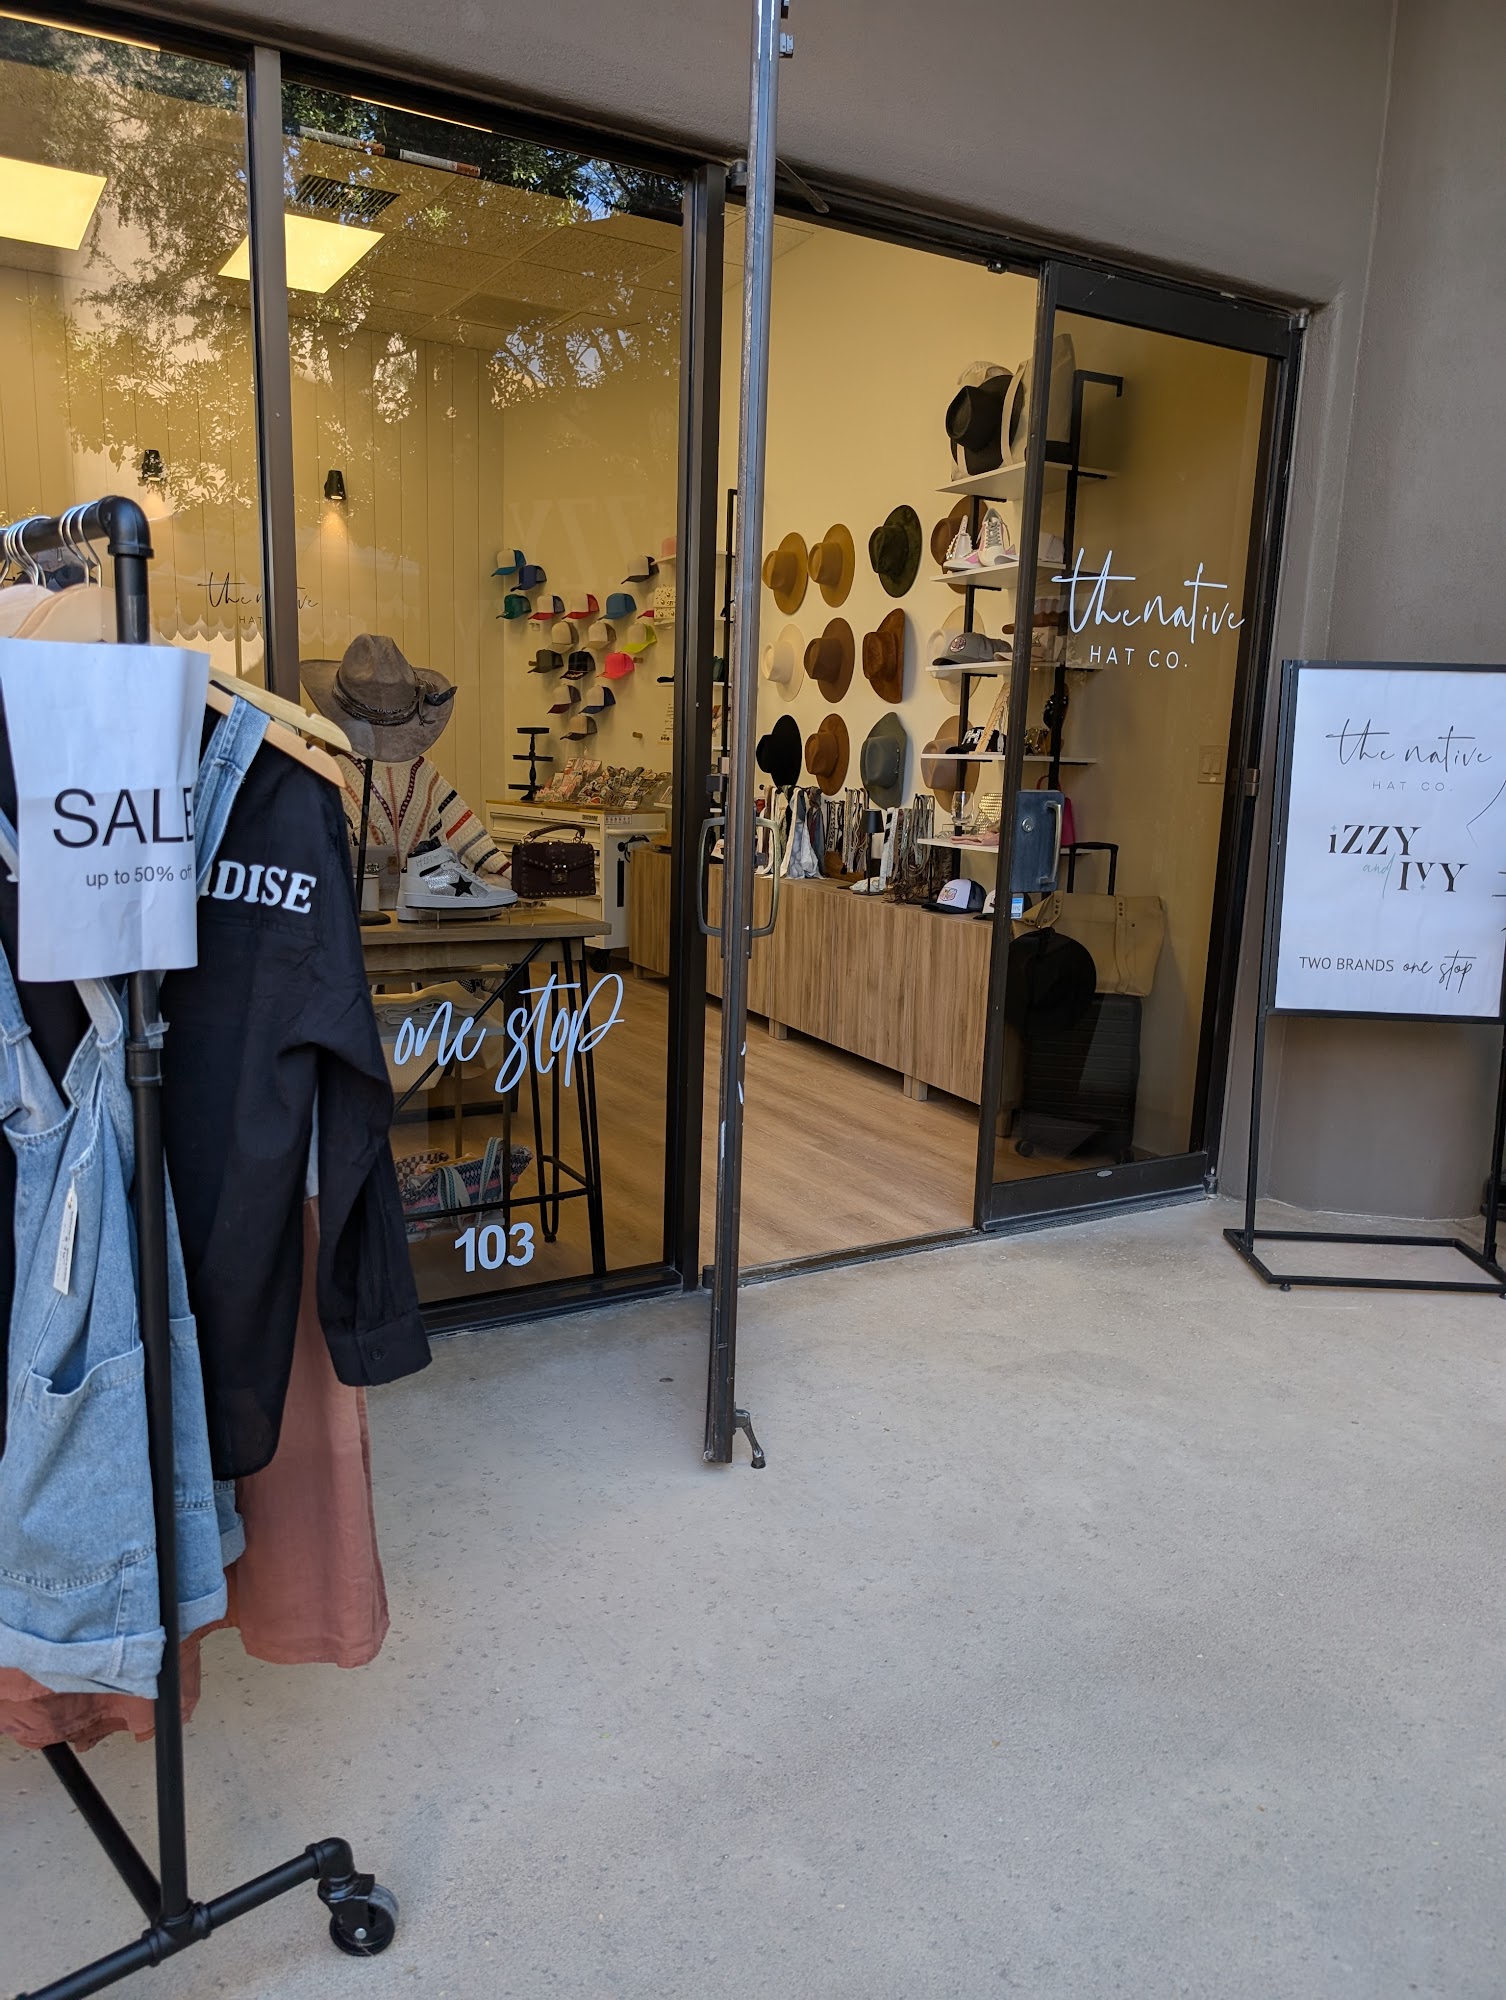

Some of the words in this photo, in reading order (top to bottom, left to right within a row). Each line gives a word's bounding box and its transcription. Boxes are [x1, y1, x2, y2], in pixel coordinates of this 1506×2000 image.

[1090, 645, 1135, 666] HAT
[1149, 649, 1188, 669] CO.
[1326, 718, 1395, 765] the
[1404, 725, 1492, 772] native
[1372, 780, 1407, 791] HAT
[1421, 782, 1453, 792] CO.
[53, 787, 194, 849] SALE
[86, 871, 109, 889] up
[114, 867, 131, 884] to
[134, 866, 174, 883] 50%
[201, 860, 317, 914] DISE
[1362, 853, 1396, 899] and
[1397, 861, 1469, 893] IVY
[1299, 956, 1332, 970] TWO
[1336, 957, 1394, 972] BRANDS
[1403, 959, 1433, 975] one
[1439, 950, 1477, 994] stop
[393, 1001, 487, 1067] one
[494, 973, 625, 1094] stop
[454, 1222, 536, 1273] 103
